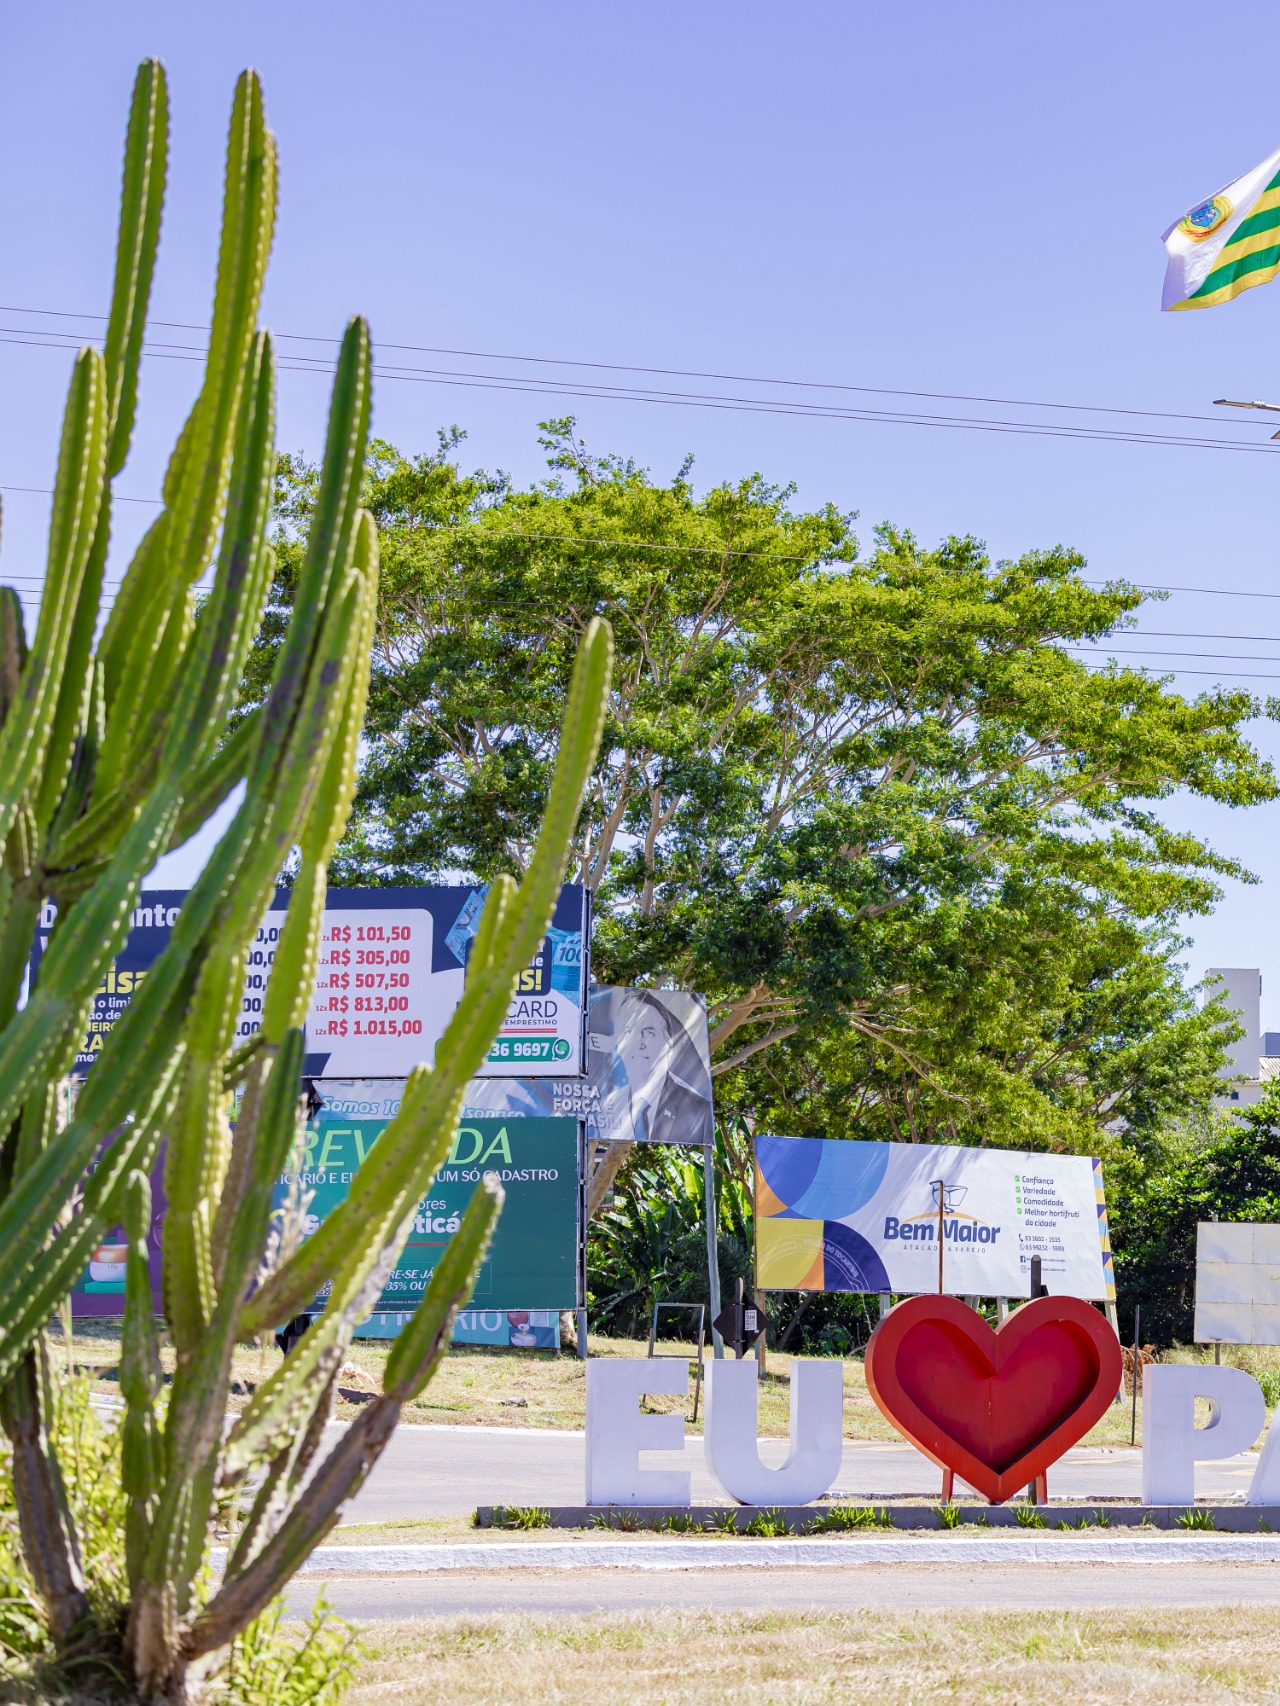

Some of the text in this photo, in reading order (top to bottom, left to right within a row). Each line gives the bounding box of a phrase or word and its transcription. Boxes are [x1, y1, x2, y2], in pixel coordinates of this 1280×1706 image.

[331, 925, 351, 943] R$
[356, 926, 411, 943] 101,50
[330, 949, 350, 966] R$
[355, 949, 410, 966] 305,00
[329, 972, 349, 990] R$
[355, 973, 410, 990] 507,50
[328, 995, 349, 1013] R$
[354, 996, 409, 1013] 813,00
[328, 1019, 348, 1037] R$
[353, 1020, 422, 1037] 1.015,00
[513, 1042, 550, 1057] 9697
[320, 1095, 379, 1115] Somos
[553, 1097, 602, 1114] FORÇA
[285, 1126, 513, 1168] REVDA
[436, 1171, 458, 1182] UM
[461, 1167, 480, 1182] SÓ
[1022, 1176, 1054, 1186] Confiança
[1022, 1186, 1056, 1195] Variedade
[1023, 1197, 1064, 1206] Comodidade
[1024, 1208, 1080, 1219] Melhor hortifruti
[884, 1217, 1001, 1244] Bem Maior
[1034, 1219, 1057, 1228] cidade
[903, 1244, 940, 1252] ATACAD
[586, 1358, 843, 1506] EU
